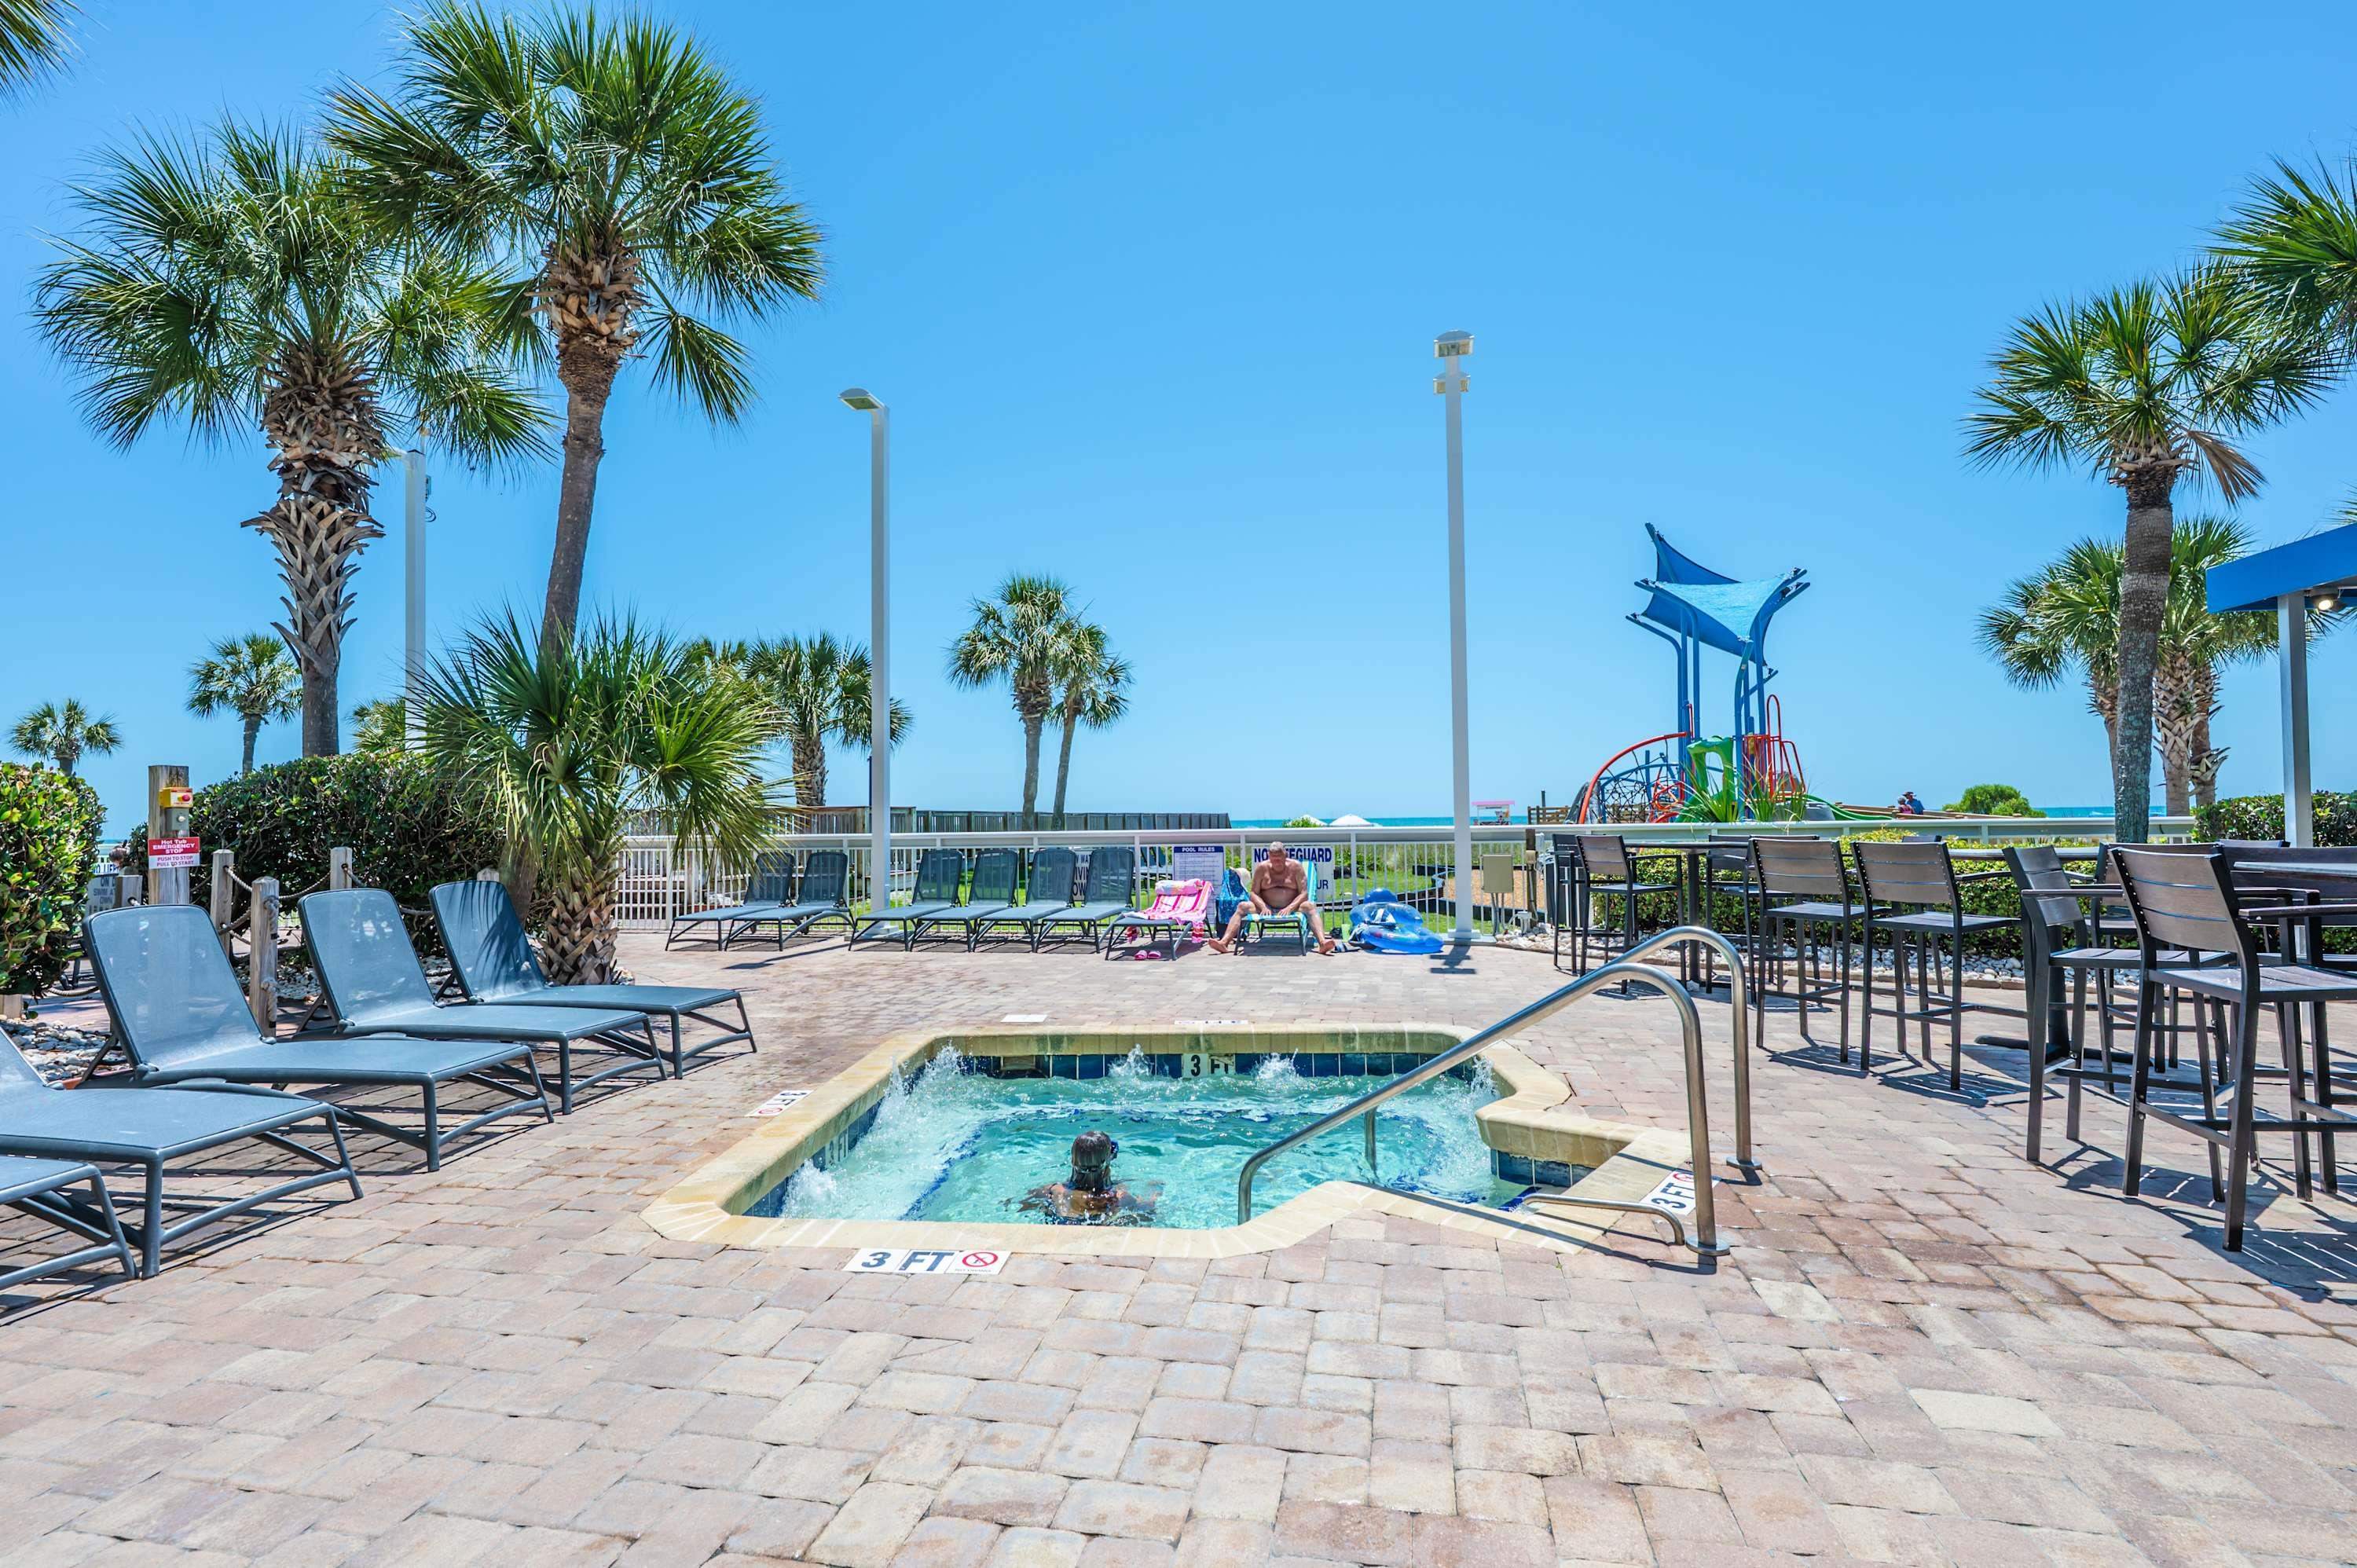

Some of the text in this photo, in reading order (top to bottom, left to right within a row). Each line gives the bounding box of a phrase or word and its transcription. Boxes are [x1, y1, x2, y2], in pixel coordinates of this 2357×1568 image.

[1254, 848, 1269, 863] NO
[1190, 1054, 1201, 1077] 3
[1651, 1181, 1695, 1209] 3 FT
[861, 1251, 955, 1272] 3 FT
